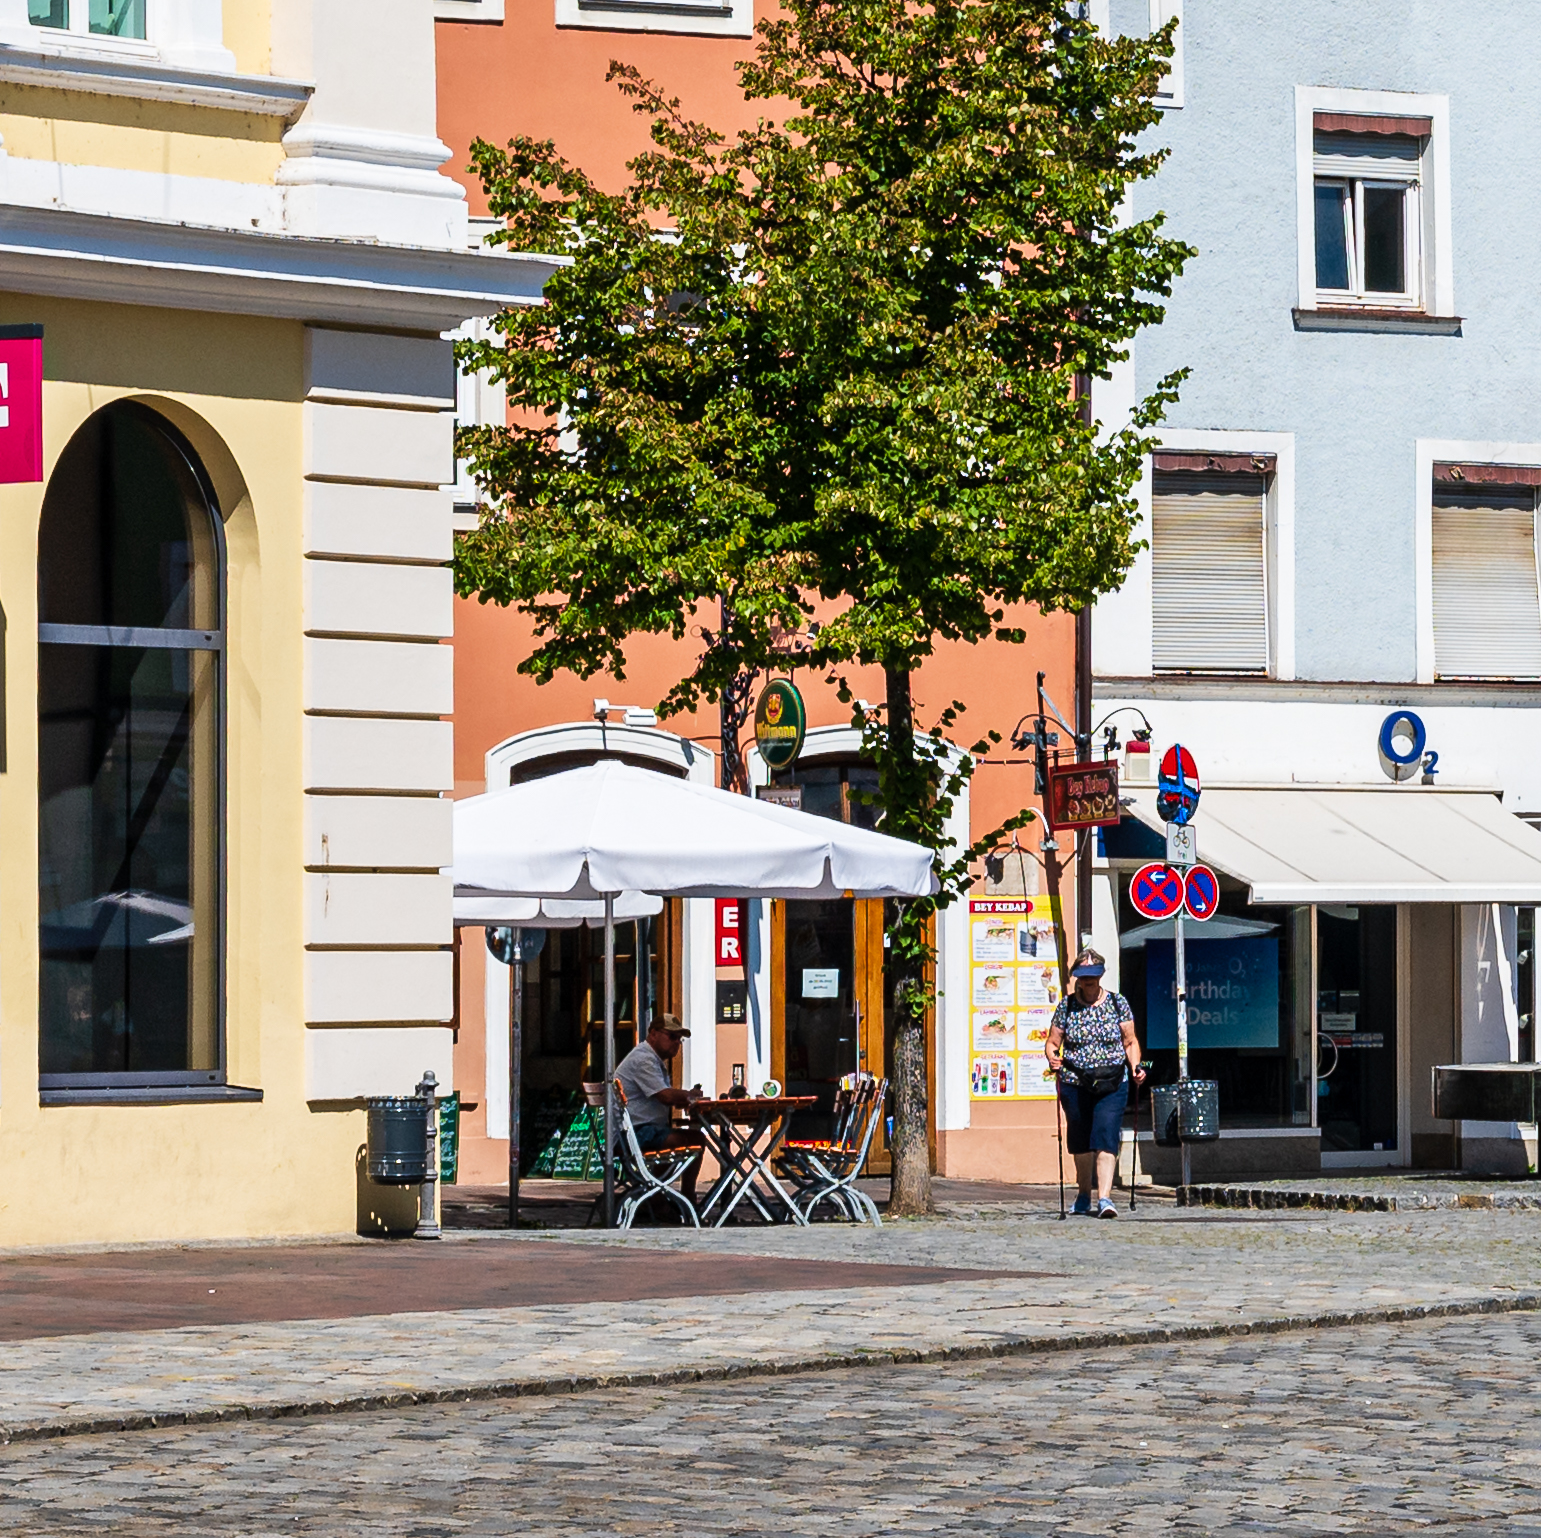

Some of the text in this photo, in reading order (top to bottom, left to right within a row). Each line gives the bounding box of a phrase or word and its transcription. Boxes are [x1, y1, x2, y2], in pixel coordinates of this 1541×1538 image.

[974, 902, 1027, 912] BEY KEBAP
[1186, 1006, 1240, 1026] Deals
